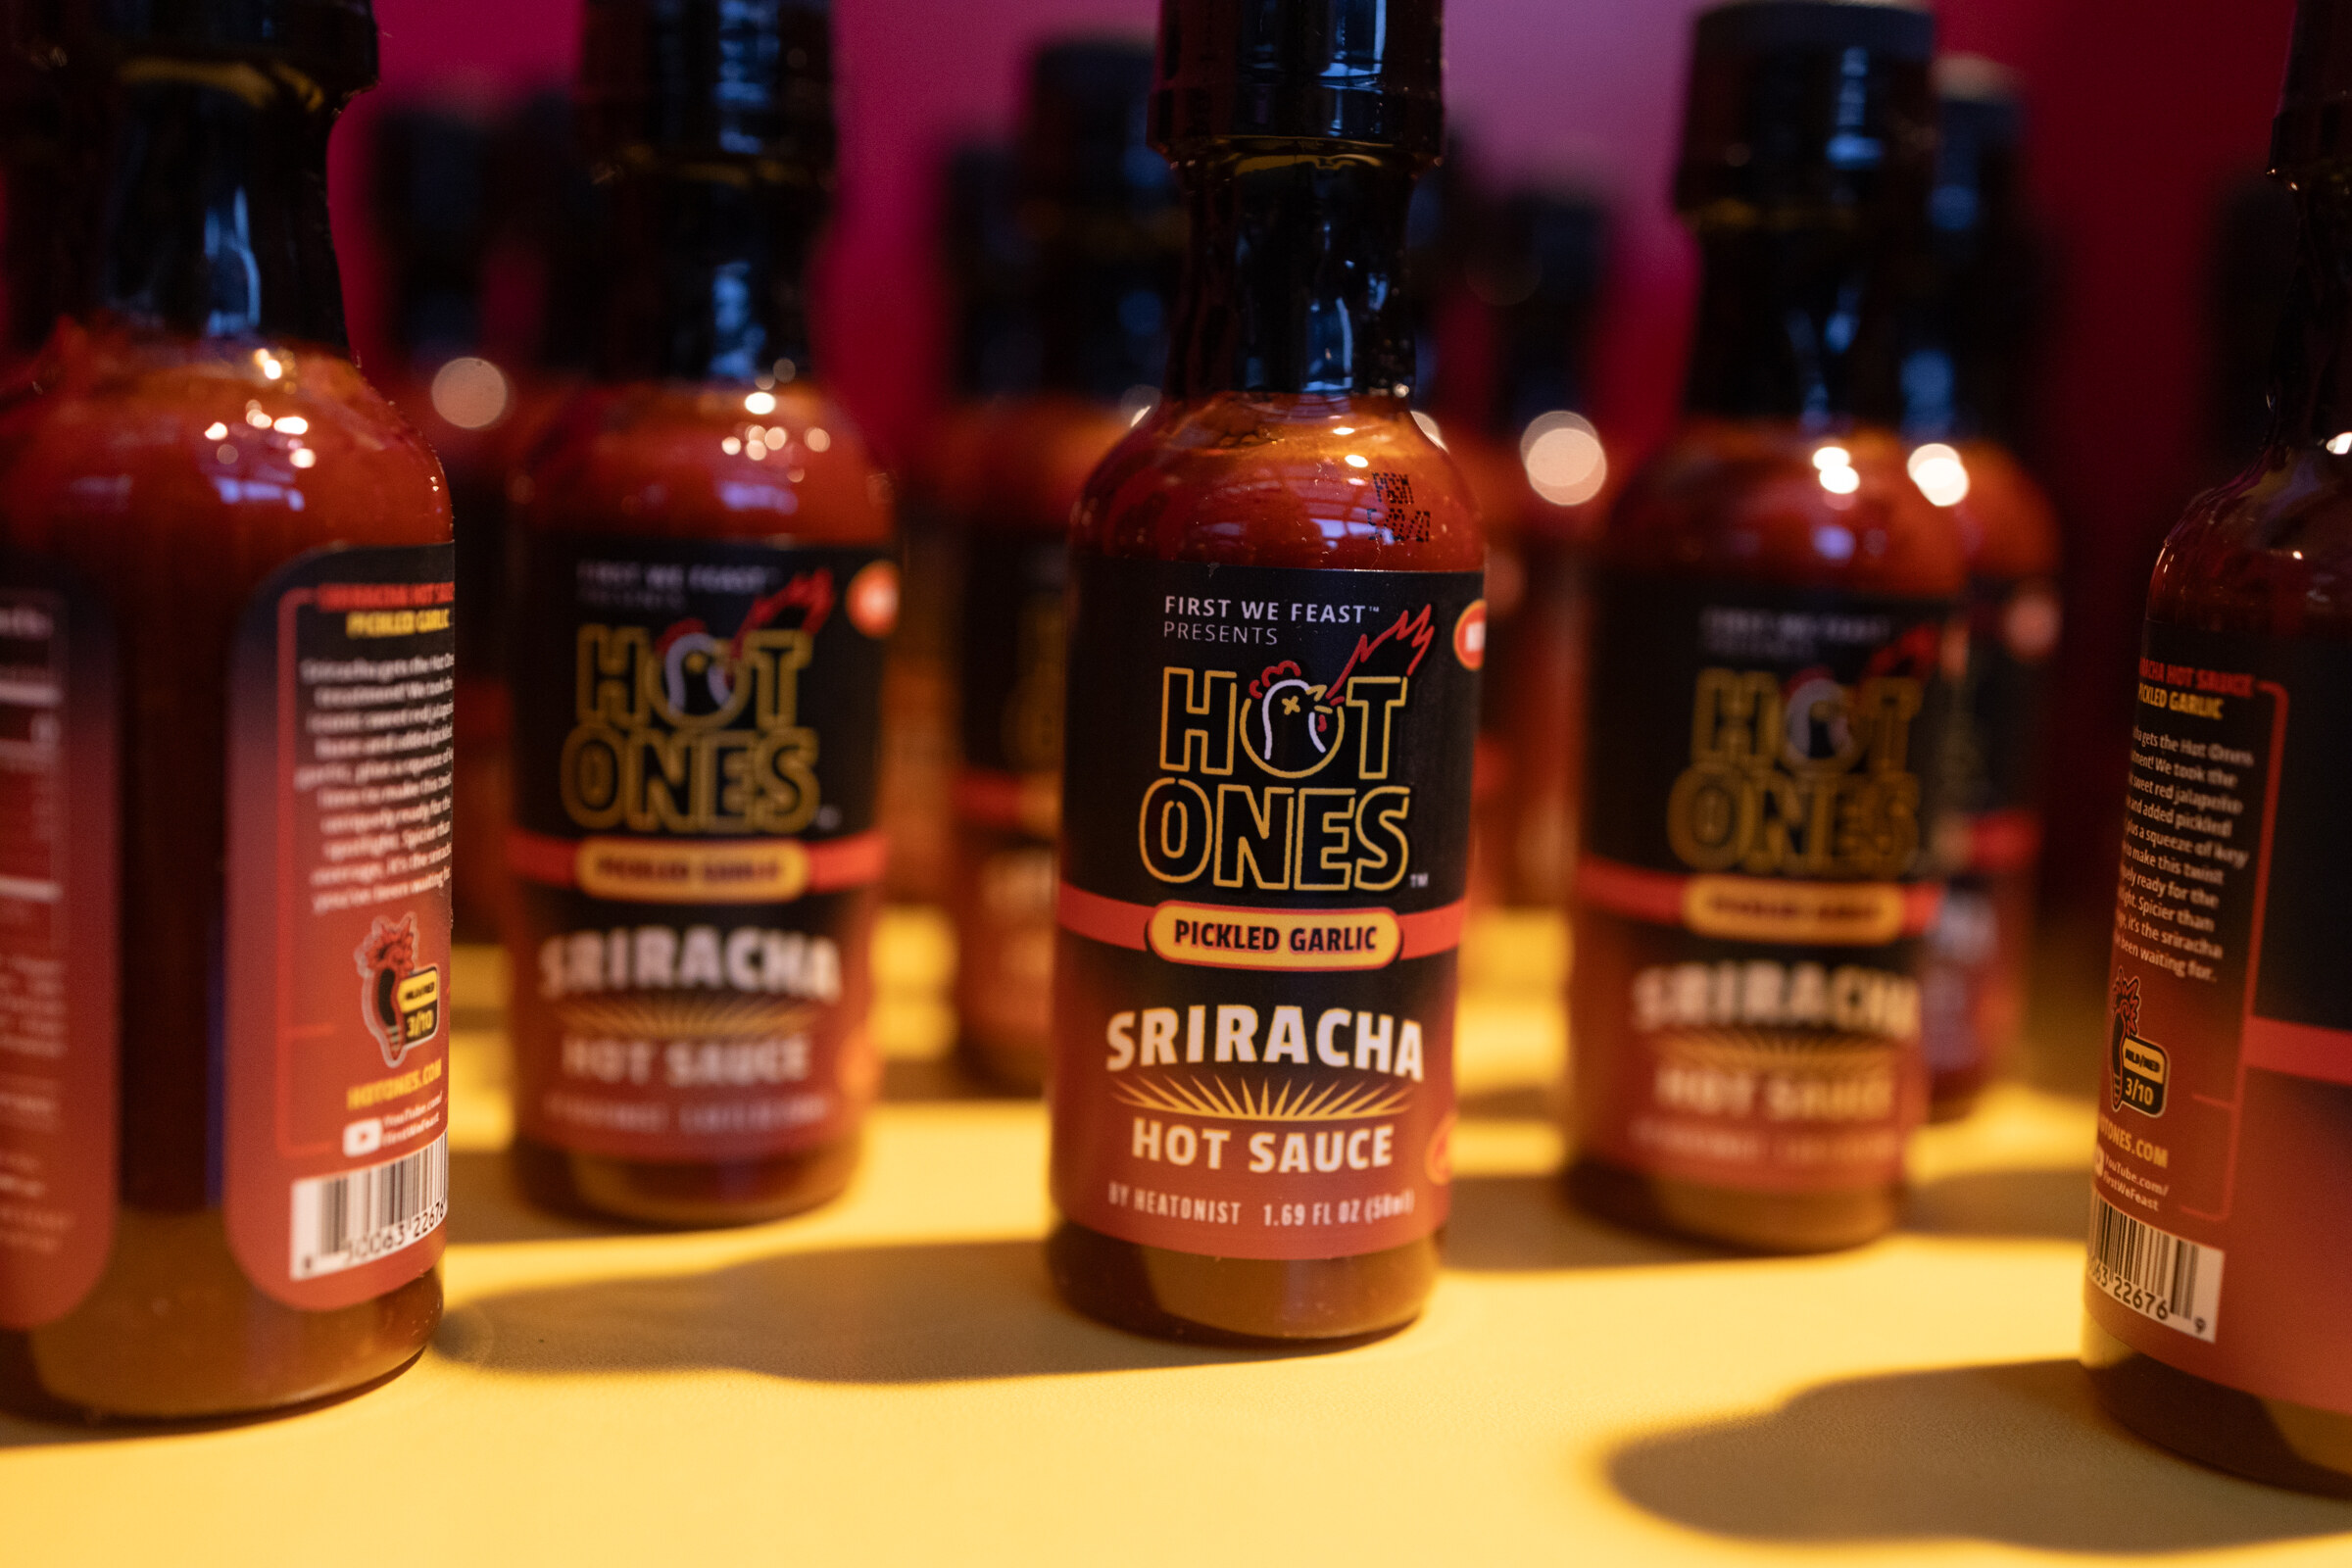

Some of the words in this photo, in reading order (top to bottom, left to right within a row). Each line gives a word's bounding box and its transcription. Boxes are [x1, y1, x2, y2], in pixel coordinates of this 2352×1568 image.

[1164, 596, 1231, 618] FIRST
[1242, 601, 1279, 621] WE
[1164, 621, 1278, 645] PRESENTS
[576, 624, 813, 732] HOT
[2169, 691, 2224, 720] GARLIC
[1160, 666, 1408, 780] HOT
[2141, 731, 2158, 747] gets
[2160, 734, 2179, 752] the
[560, 725, 820, 833] ONES
[2155, 757, 2172, 774] We
[2174, 763, 2205, 782] took
[2133, 775, 2153, 794] sweet
[2154, 784, 2174, 800] red
[2132, 798, 2142, 813] and
[2143, 804, 2174, 823] added
[1139, 777, 1410, 891] ONES
[2139, 827, 2144, 839] a
[2145, 829, 2193, 854] squeeze
[2132, 847, 2156, 866] make
[2158, 856, 2181, 874] this
[2136, 875, 2166, 898] ready
[2167, 880, 2188, 901] for
[2138, 896, 2176, 920] Spicier
[2177, 908, 2215, 932] than
[1175, 919, 1280, 952] PICKLED
[1290, 926, 1377, 952] GARLIC
[2141, 922, 2159, 941] the
[540, 926, 841, 1004] SRIRACHA
[2121, 936, 2138, 956] been
[2140, 948, 2185, 978] waiting
[407, 1008, 434, 1038] 3/10
[1106, 1004, 1424, 1082] SRIRACHA
[347, 1058, 441, 1110] HOTONES.COM
[2125, 1077, 2154, 1106] 3/10
[1132, 1117, 1231, 1169] HOT
[1249, 1125, 1394, 1173] SAUCE
[2103, 1170, 2159, 1211] FirstWeFeast
[2106, 1152, 2170, 1197] YouTube.com/
[1108, 1181, 1128, 1207] BY
[1134, 1188, 1241, 1224] HEATONIST
[1264, 1203, 1305, 1226] 1.69
[1312, 1201, 1332, 1225] FL
[1338, 1199, 1360, 1224] OZ
[2113, 1276, 2169, 1320] 22676
[2194, 1317, 2206, 1335] 9
